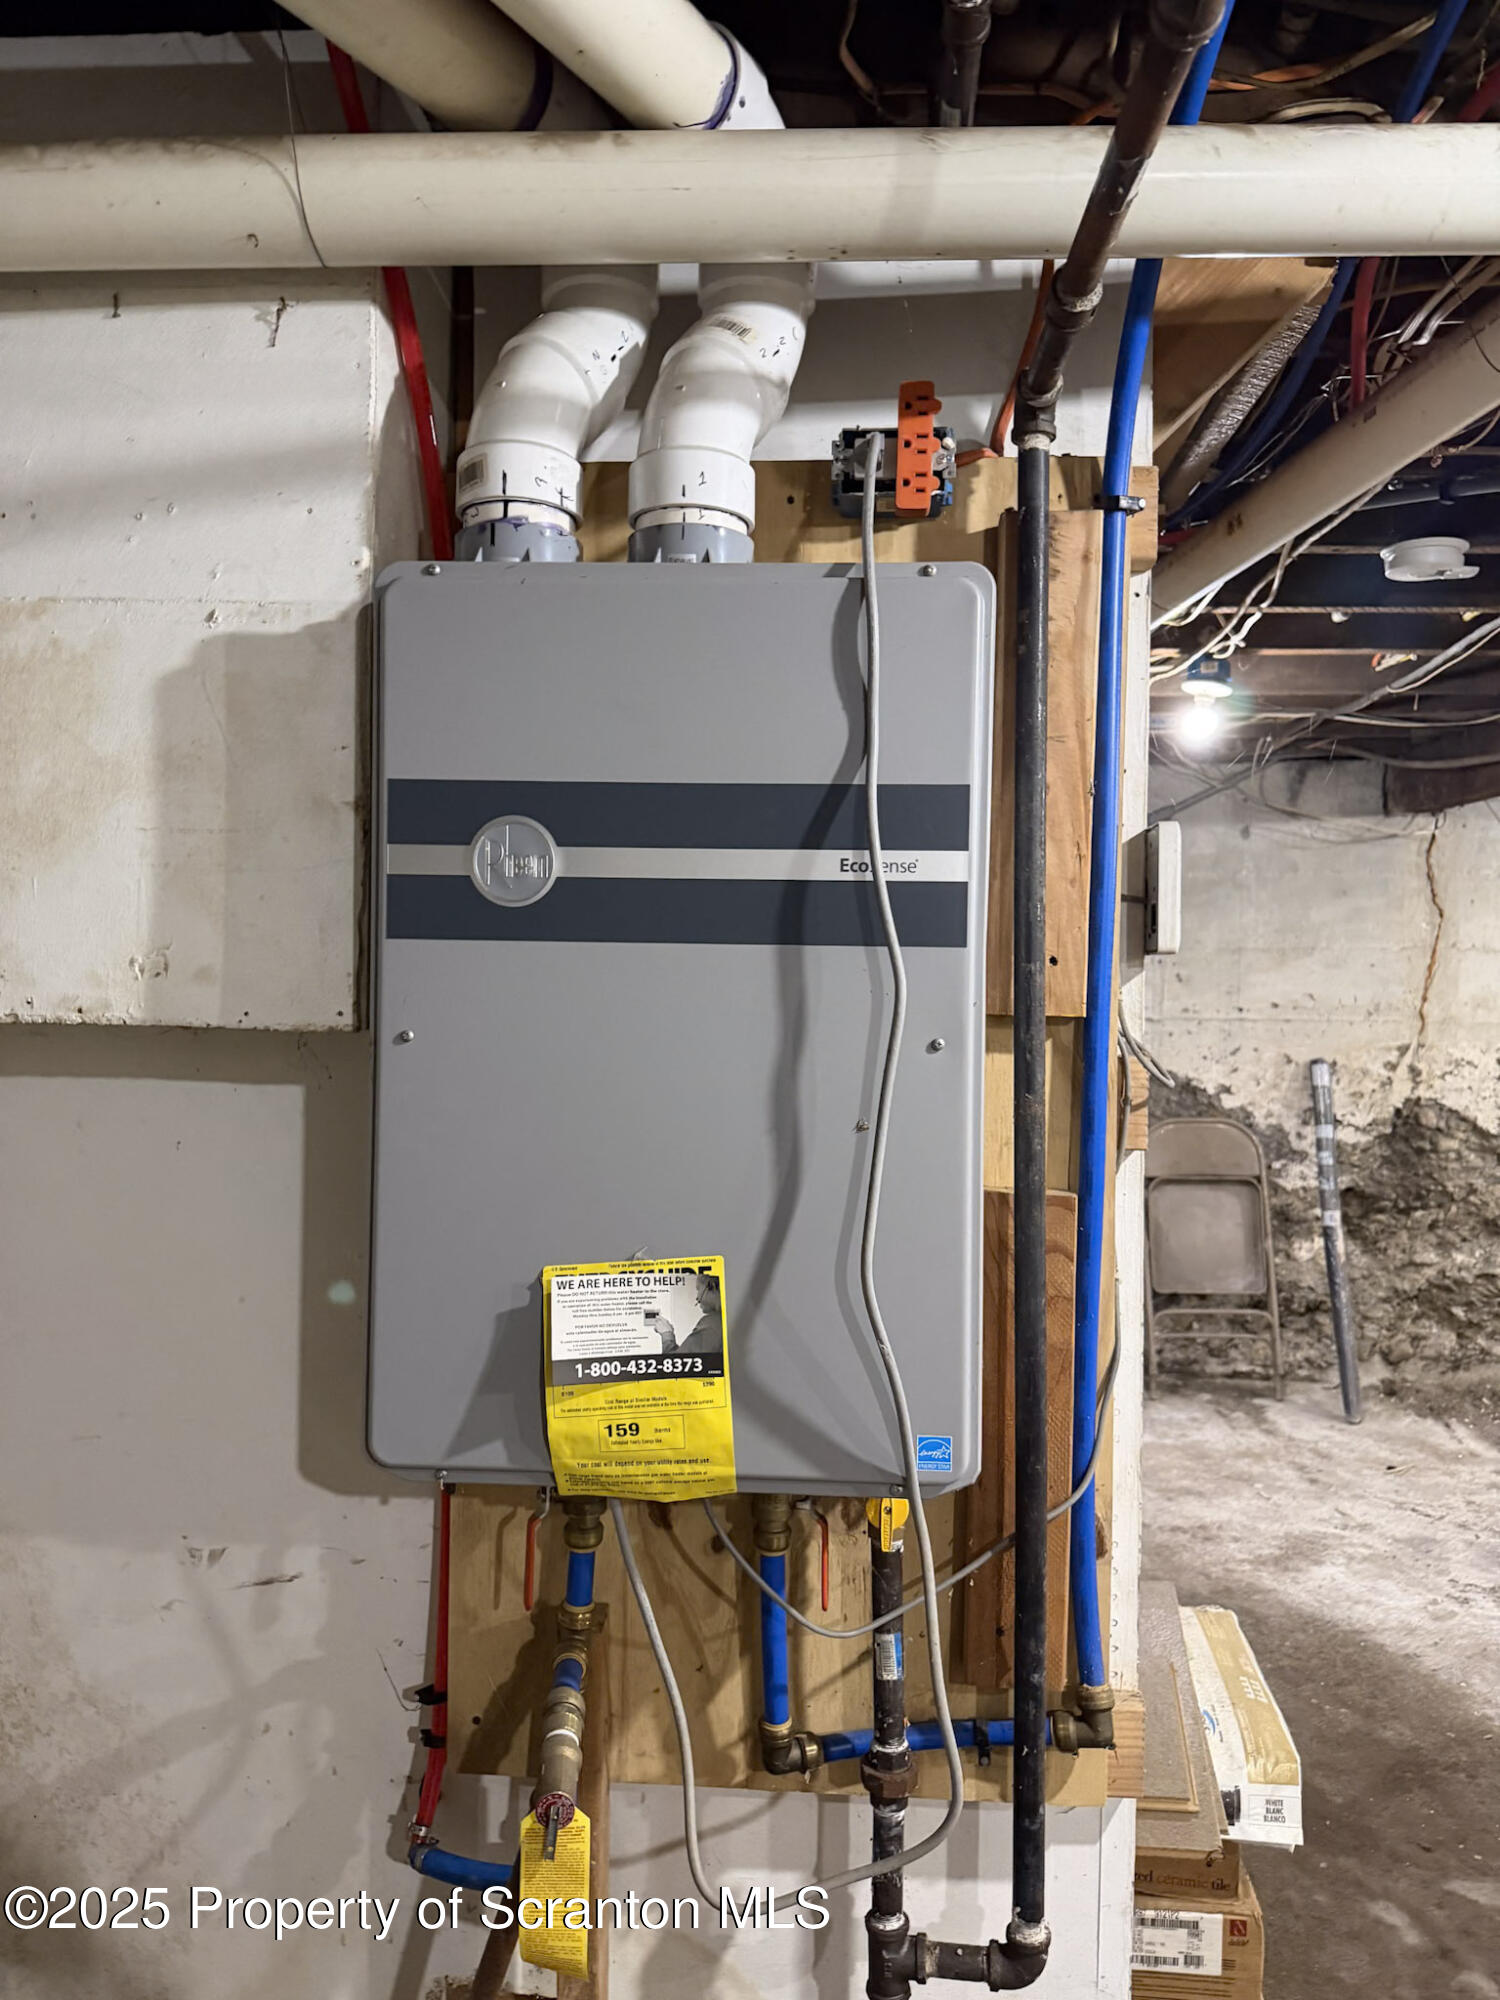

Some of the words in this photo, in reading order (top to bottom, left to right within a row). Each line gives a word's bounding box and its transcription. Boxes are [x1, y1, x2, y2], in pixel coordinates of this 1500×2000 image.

[484, 824, 549, 889] Rheem
[840, 857, 917, 874] Ecoense
[556, 1280, 575, 1290] WE
[577, 1278, 600, 1289] ARE
[603, 1277, 633, 1288] HERE
[635, 1276, 651, 1287] TO
[653, 1276, 686, 1286] HELP!
[575, 1357, 703, 1379] 1-800-432-8373
[603, 1422, 640, 1438] 159
[1264, 1799, 1284, 1808] WHITE
[1265, 1807, 1284, 1815] BLANC
[1263, 1814, 1286, 1824] BLANCO
